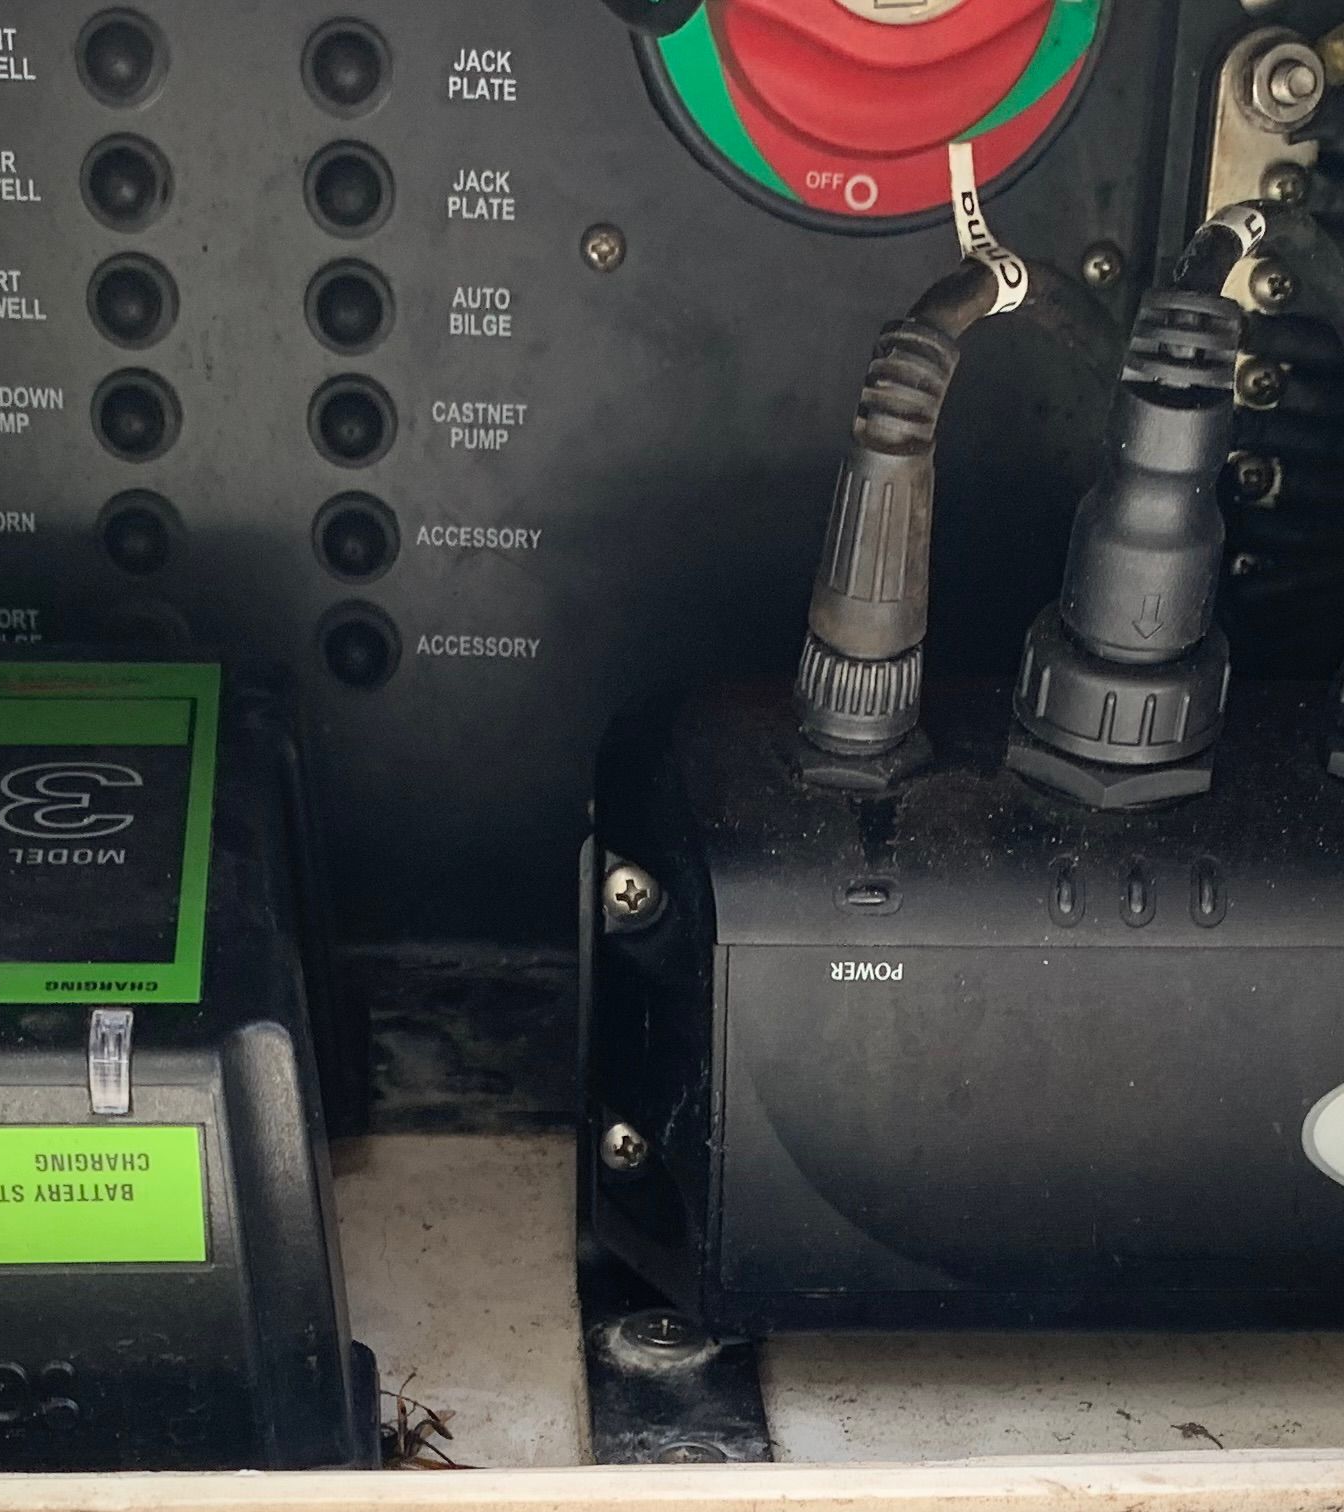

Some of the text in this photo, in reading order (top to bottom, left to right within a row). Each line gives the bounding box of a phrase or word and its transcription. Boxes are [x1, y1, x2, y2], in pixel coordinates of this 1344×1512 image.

[453, 48, 512, 73] JACK
[448, 75, 517, 101] PLATE
[453, 169, 510, 193] JACK
[806, 171, 844, 190] OFF
[447, 196, 515, 221] PLATE
[452, 286, 510, 310] AUTO
[449, 312, 512, 337] BILGE
[432, 400, 527, 425] CASTNET
[450, 426, 509, 450] PUMP
[416, 525, 542, 549] ACCESSORY
[416, 634, 540, 658] ACCESSORY
[8, 848, 126, 865] MODEL
[830, 961, 903, 981] POWER
[45, 981, 158, 992] CHARGING
[34, 1152, 150, 1173] CHARGING
[34, 1183, 134, 1203] BATTERY
